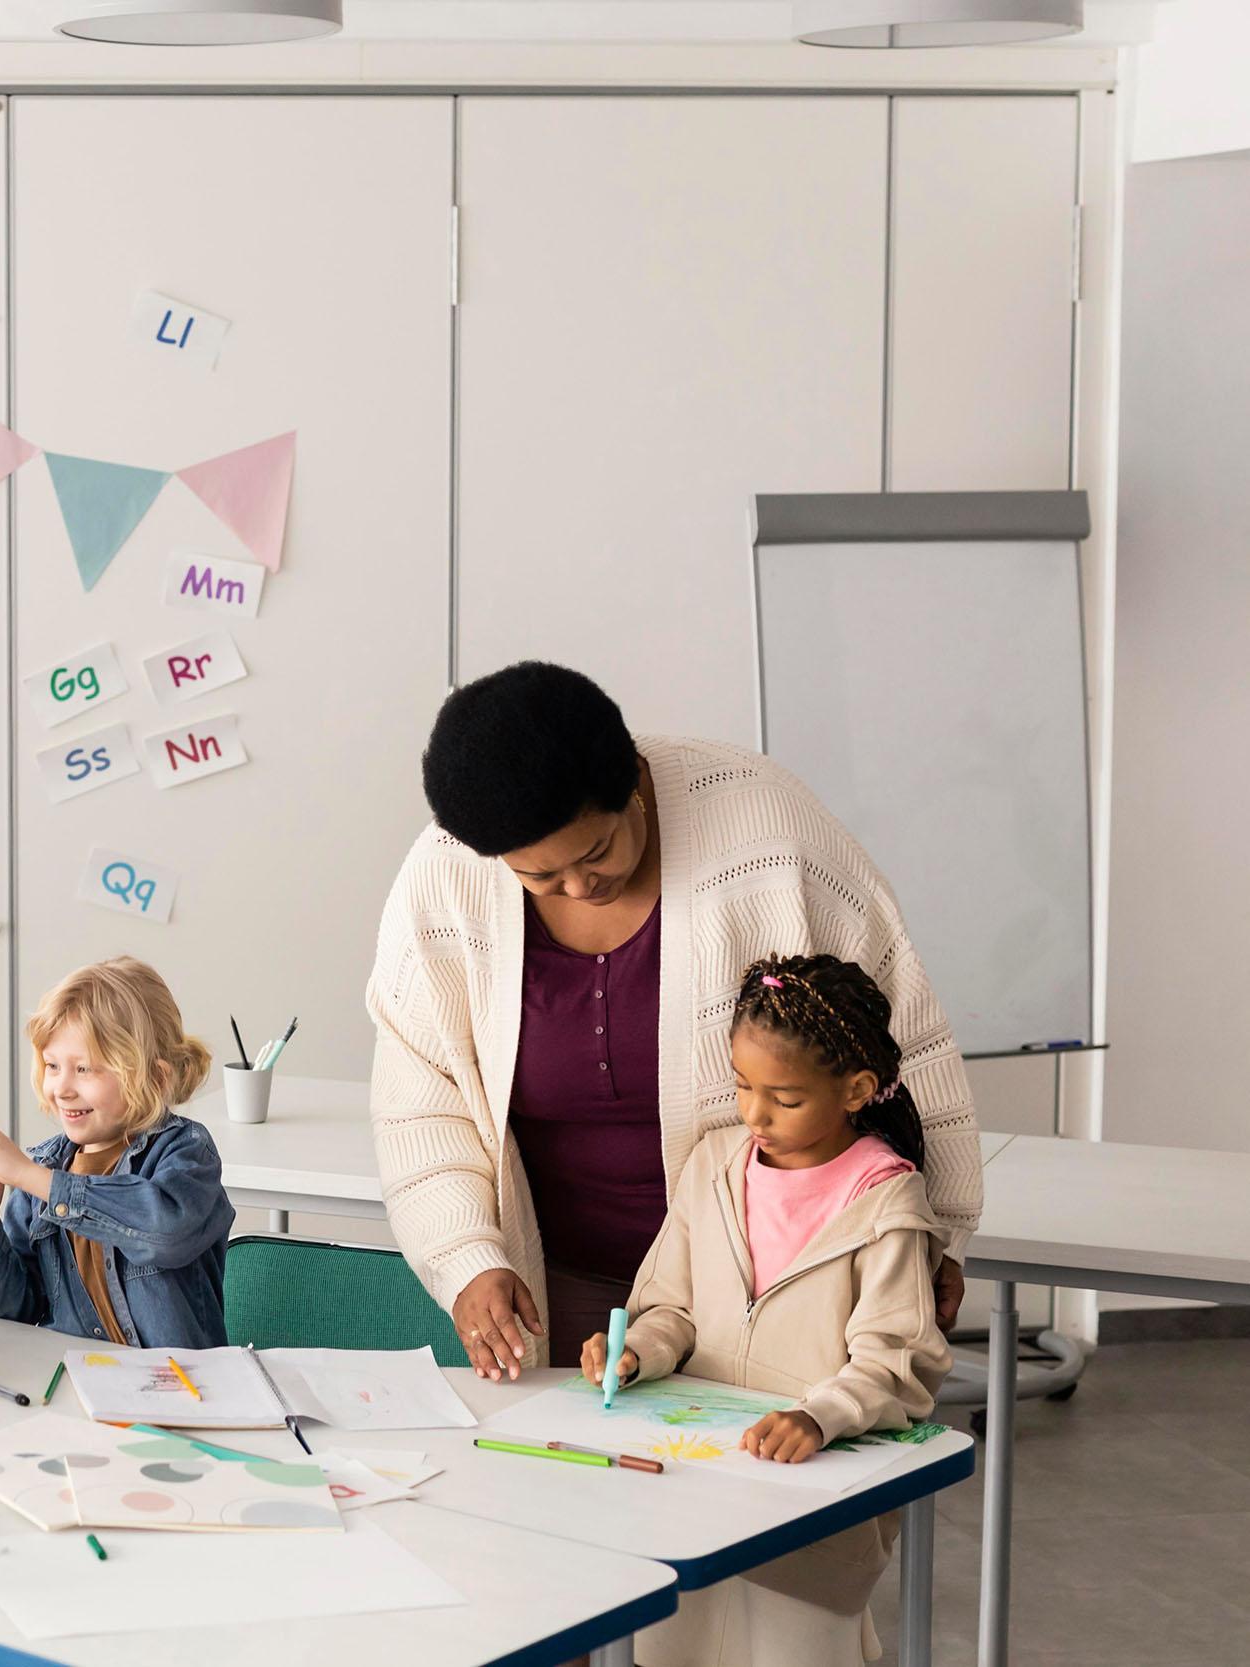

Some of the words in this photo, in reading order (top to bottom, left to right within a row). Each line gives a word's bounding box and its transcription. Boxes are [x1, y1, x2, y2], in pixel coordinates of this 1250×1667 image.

[180, 565, 244, 604] Mm
[50, 667, 100, 701] Gg
[168, 654, 211, 687] Rr
[65, 747, 111, 781] Ss
[165, 733, 221, 770] Nn
[102, 862, 156, 912] Qq
